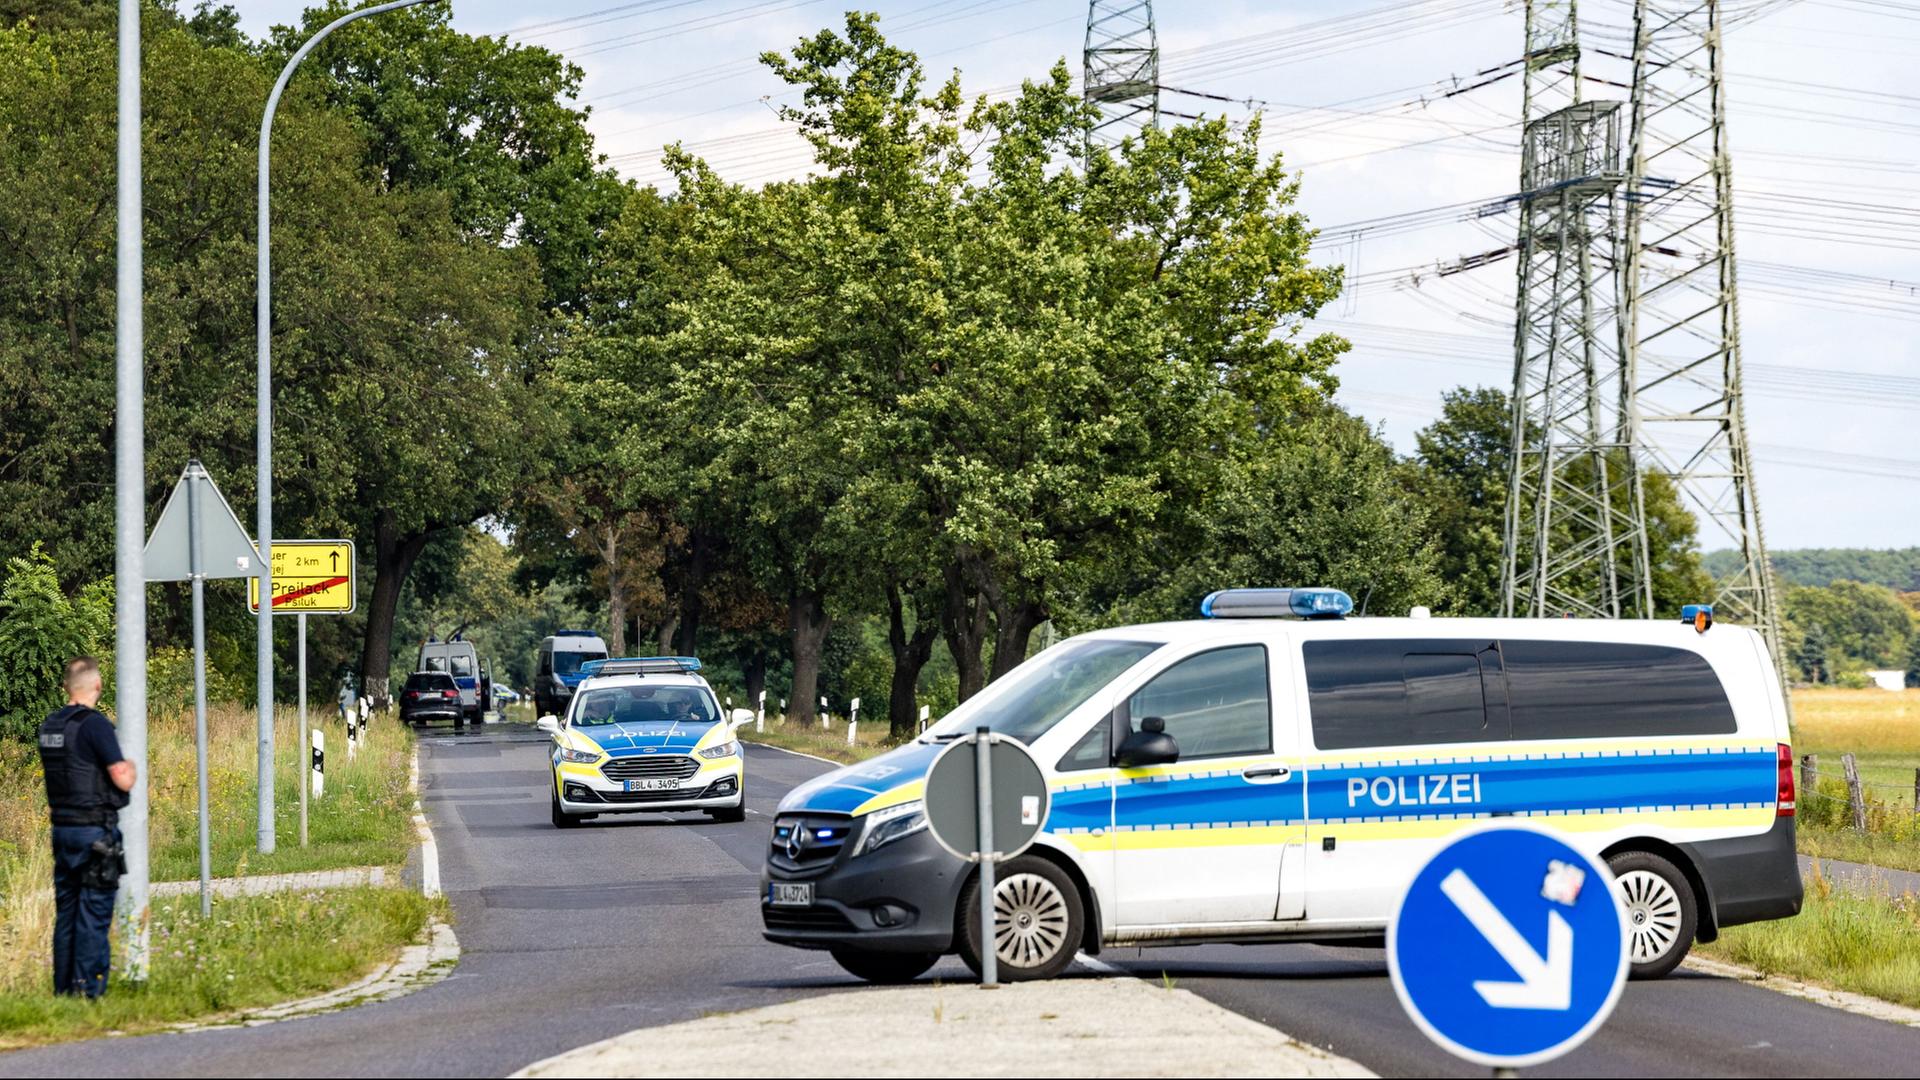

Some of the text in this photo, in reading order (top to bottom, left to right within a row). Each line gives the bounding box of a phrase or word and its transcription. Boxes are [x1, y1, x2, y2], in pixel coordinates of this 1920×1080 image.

[296, 556, 319, 566] 2 km
[271, 581, 330, 595] Preilack
[609, 730, 687, 739] POLIZEI
[1347, 773, 1482, 808] POLIZEI
